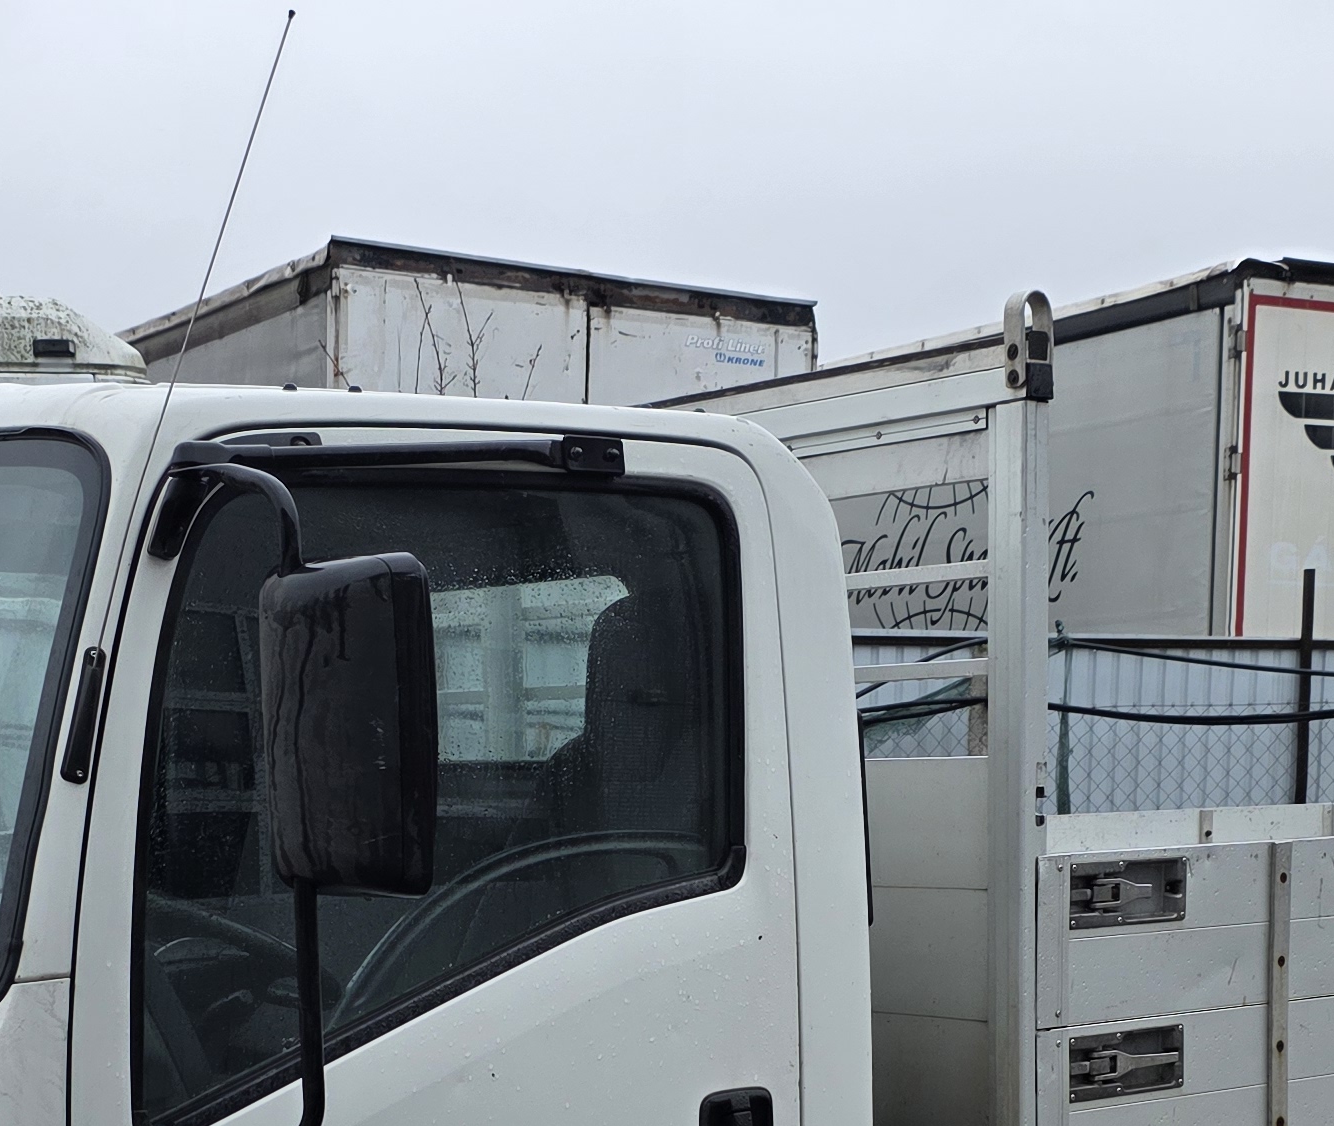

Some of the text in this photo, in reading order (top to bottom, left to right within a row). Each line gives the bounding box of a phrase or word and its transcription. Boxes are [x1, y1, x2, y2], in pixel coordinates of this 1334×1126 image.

[685, 334, 766, 355] Profi Liner
[727, 355, 765, 367] KRONE
